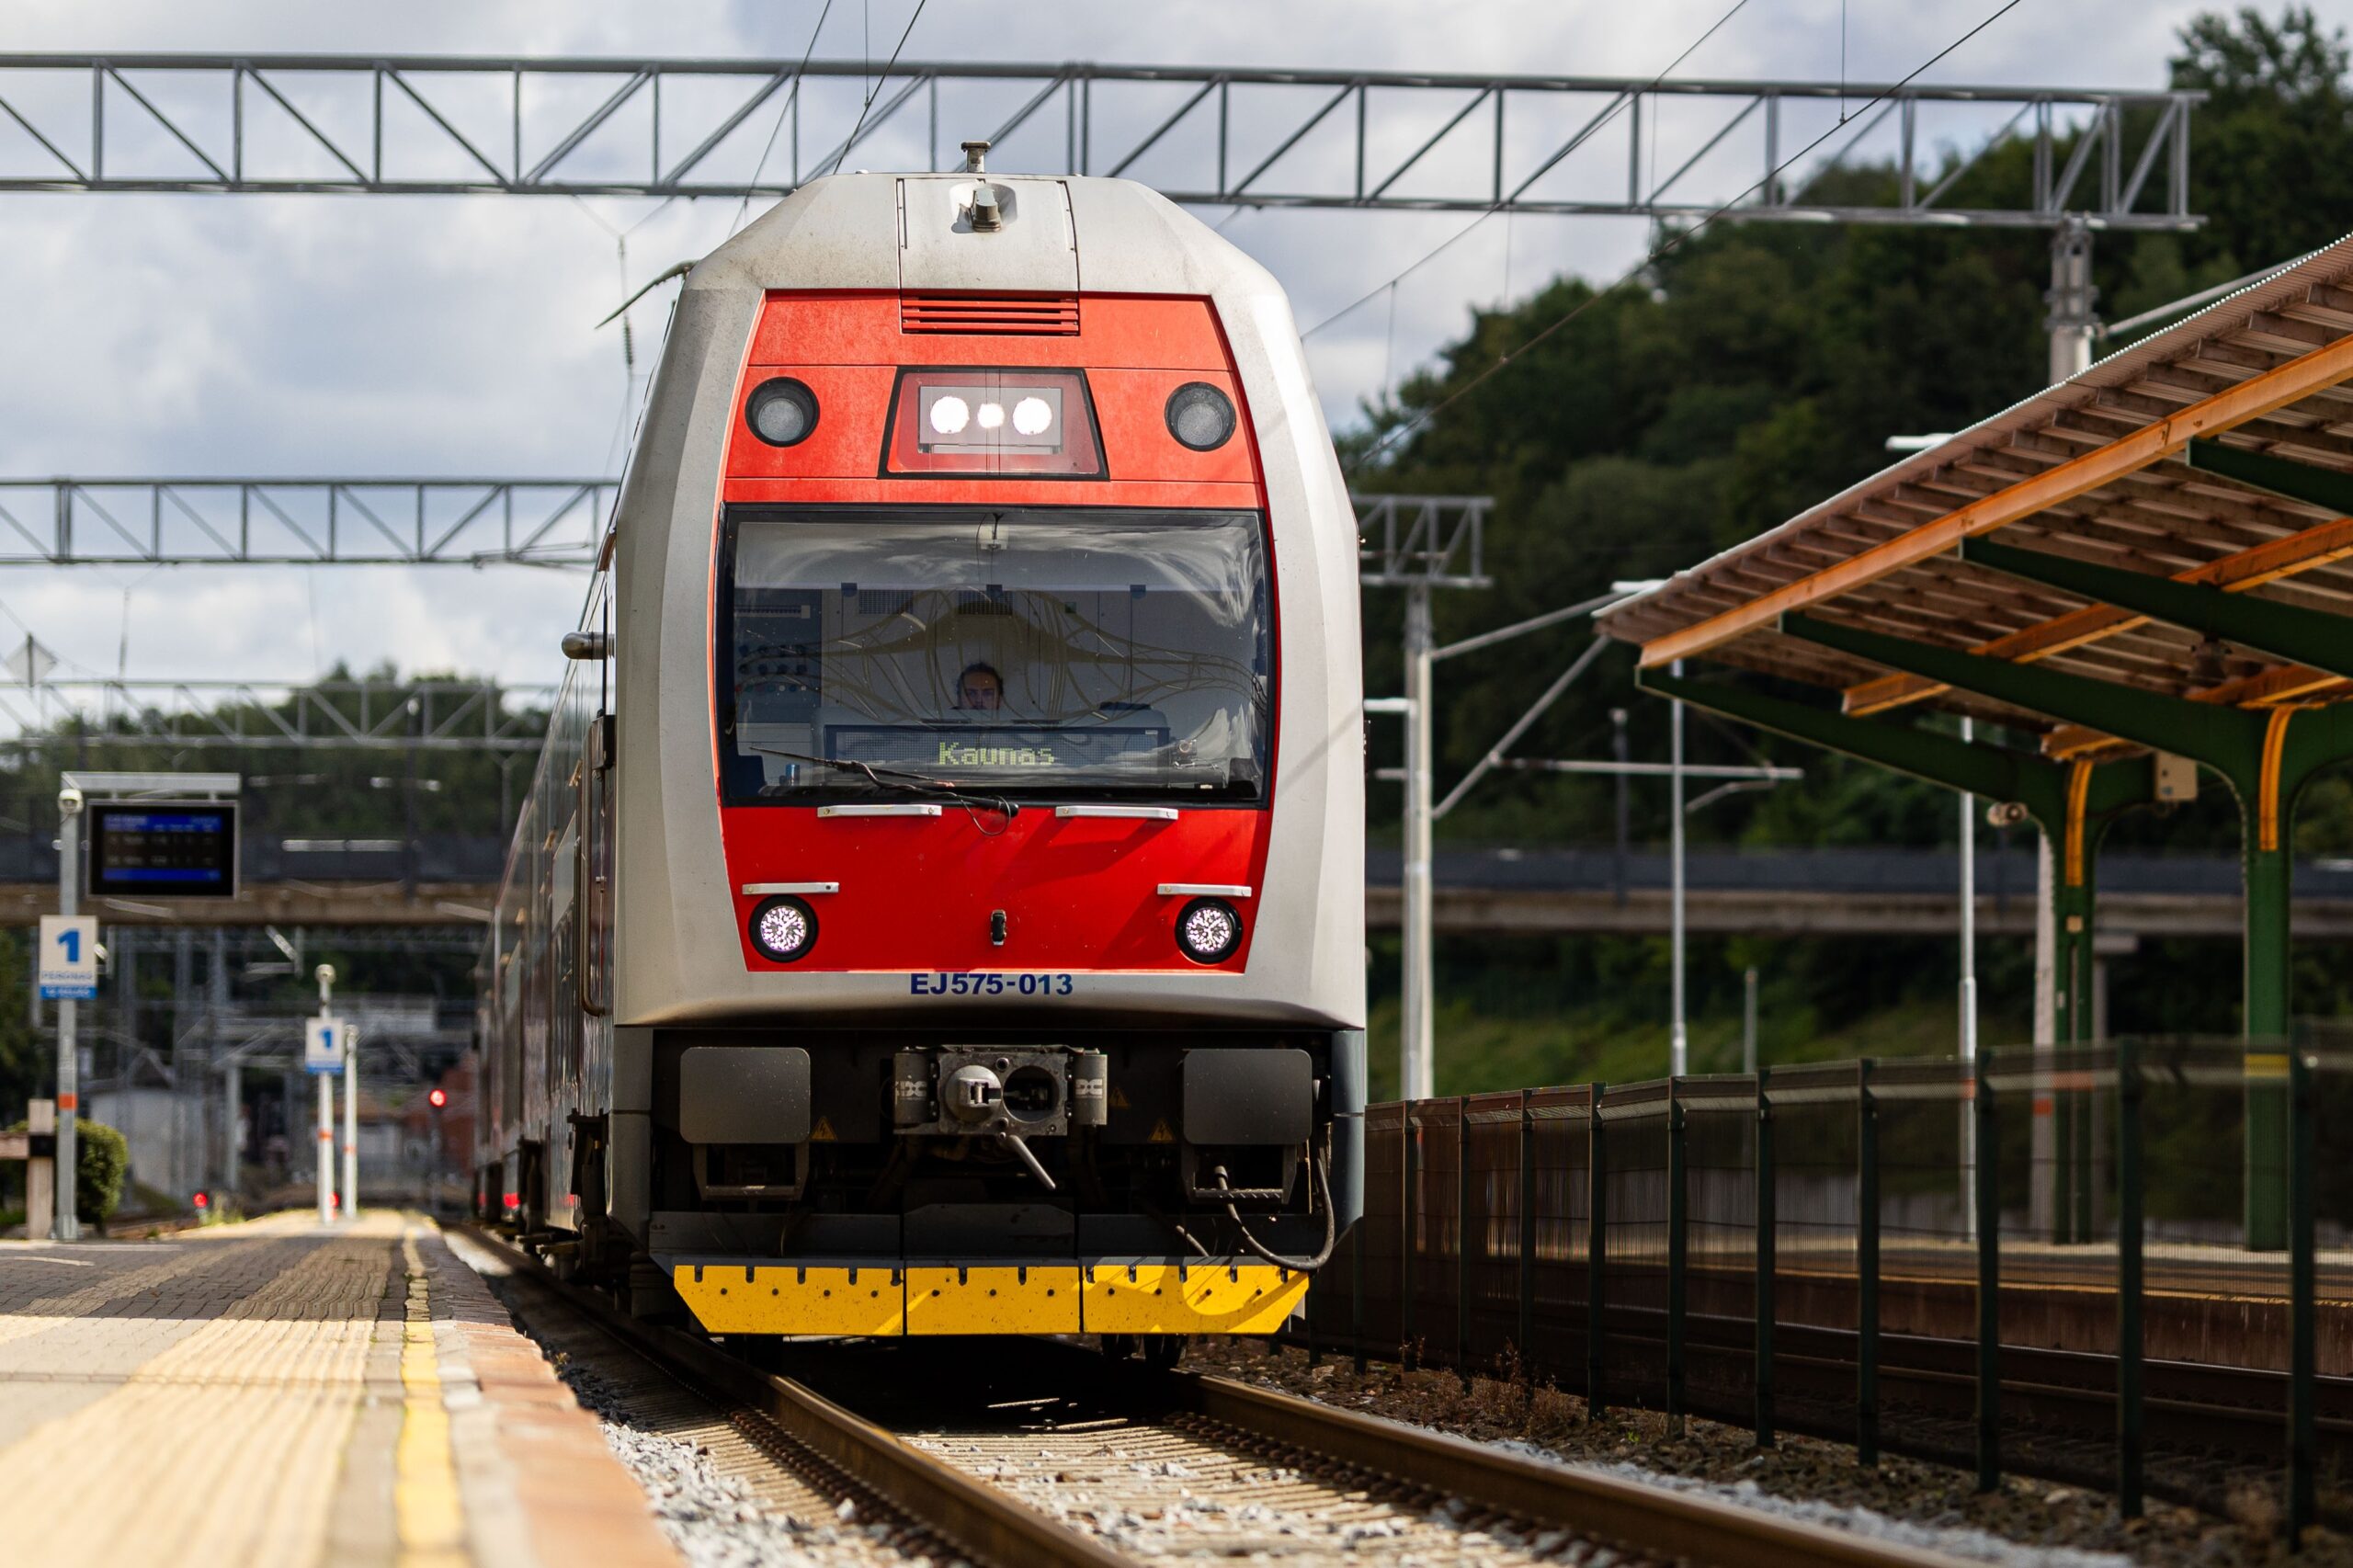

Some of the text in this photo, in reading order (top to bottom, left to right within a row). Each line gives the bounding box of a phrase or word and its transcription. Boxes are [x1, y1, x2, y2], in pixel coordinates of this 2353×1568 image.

[939, 742, 1054, 766] Kaunas
[58, 929, 79, 963] 1
[910, 972, 1074, 995] EJ575-013
[319, 1028, 333, 1050] 1
